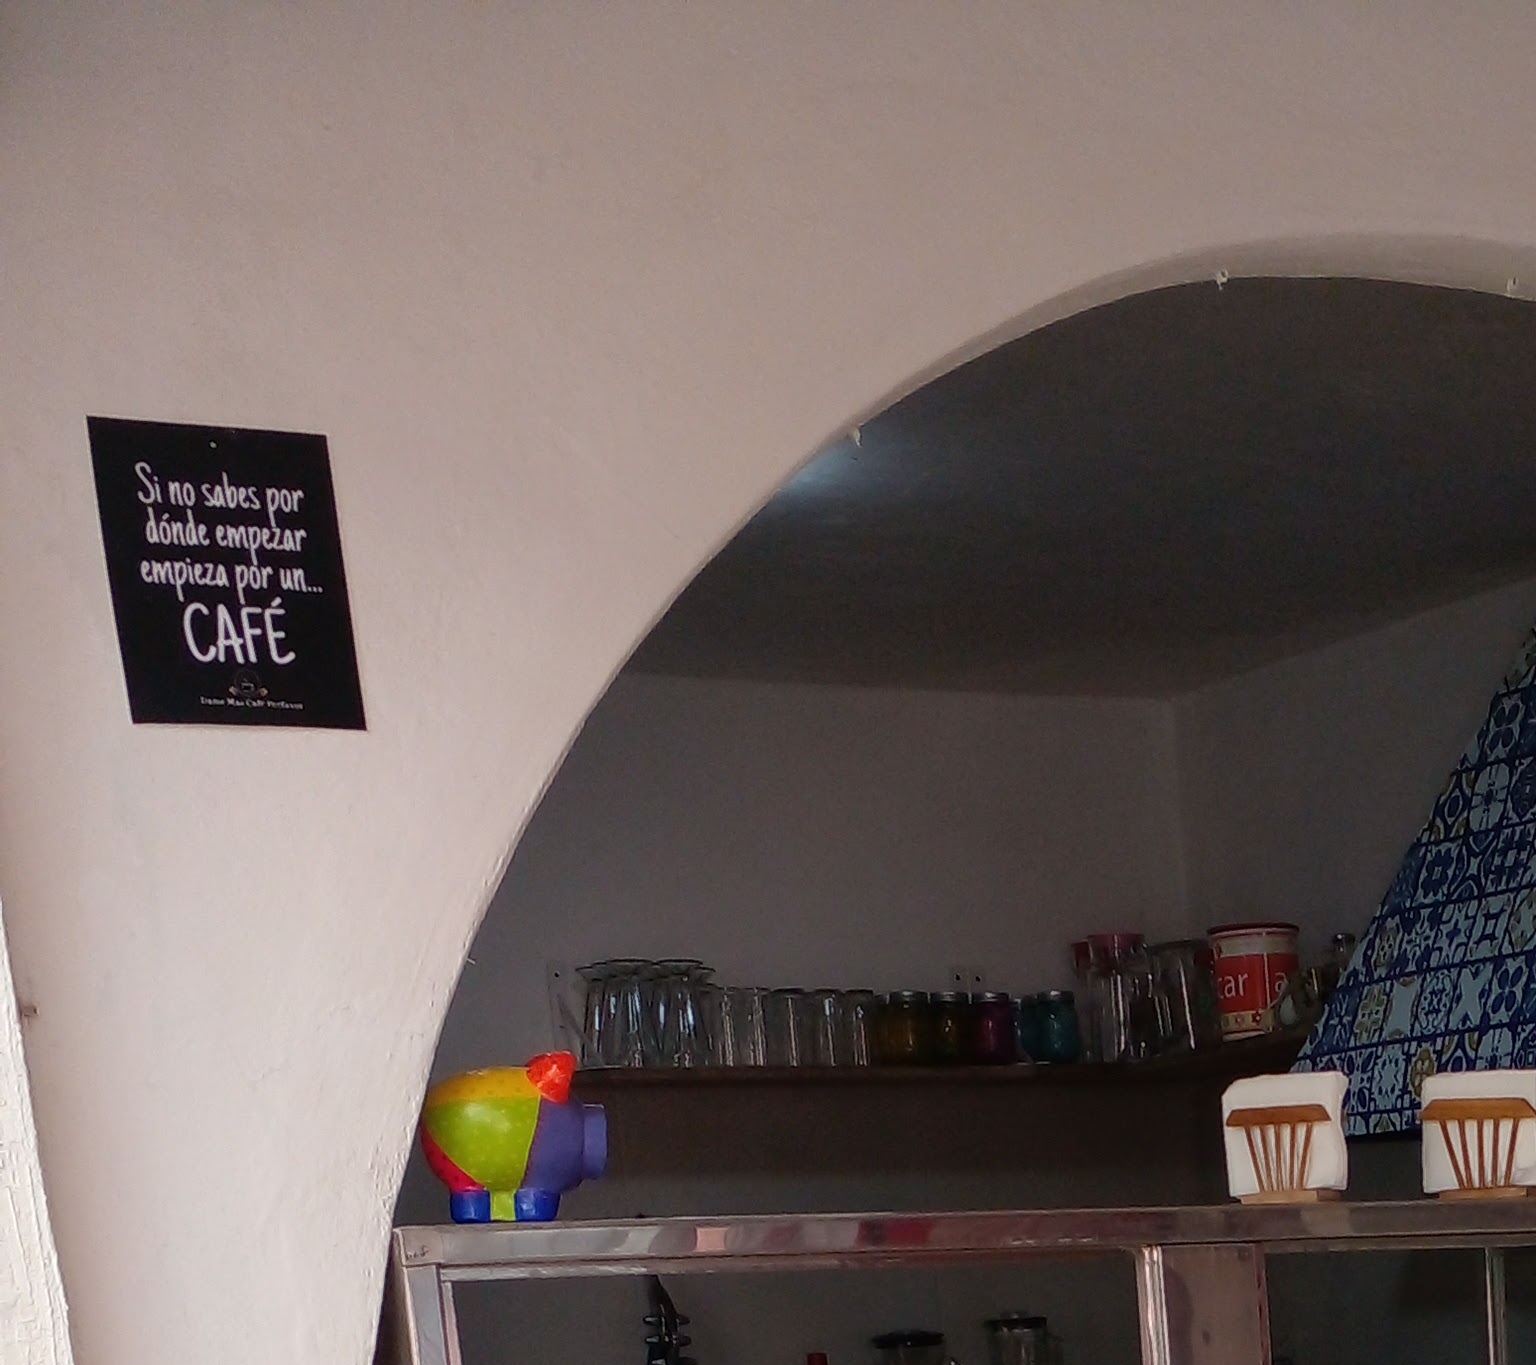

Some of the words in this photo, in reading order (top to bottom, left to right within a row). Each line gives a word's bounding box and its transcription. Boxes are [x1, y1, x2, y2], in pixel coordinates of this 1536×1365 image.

[134, 461, 162, 505] Si
[168, 480, 196, 507] no
[202, 471, 260, 510] sabes
[266, 486, 305, 527] por
[145, 507, 210, 547] dónde
[215, 524, 307, 565] empezar
[140, 557, 229, 603] empieza
[235, 564, 273, 605] por
[279, 567, 324, 594] un...
[182, 597, 296, 665] CAFÉ
